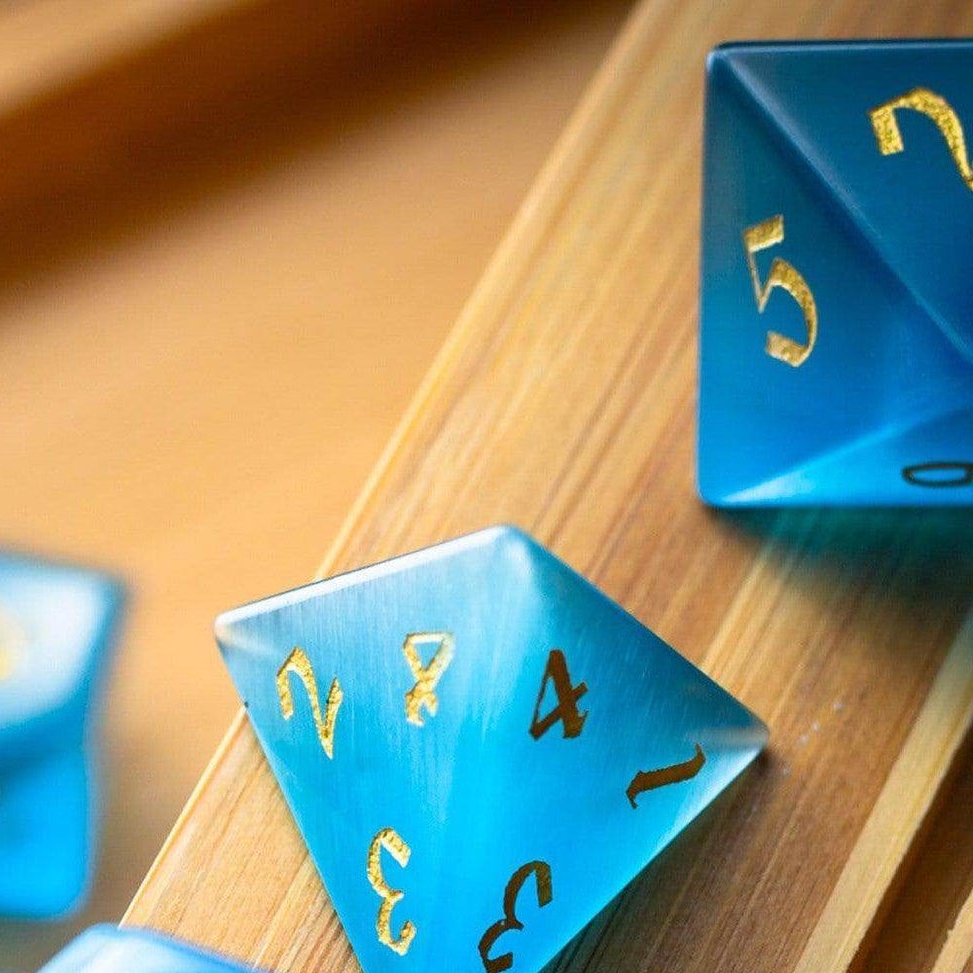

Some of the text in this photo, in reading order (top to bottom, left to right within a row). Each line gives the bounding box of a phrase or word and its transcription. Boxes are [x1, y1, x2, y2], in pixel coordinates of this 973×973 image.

[744, 214, 817, 368] 5
[276, 646, 343, 760] 2
[529, 649, 587, 741] 4
[626, 743, 706, 810] 1
[367, 827, 416, 957] 3
